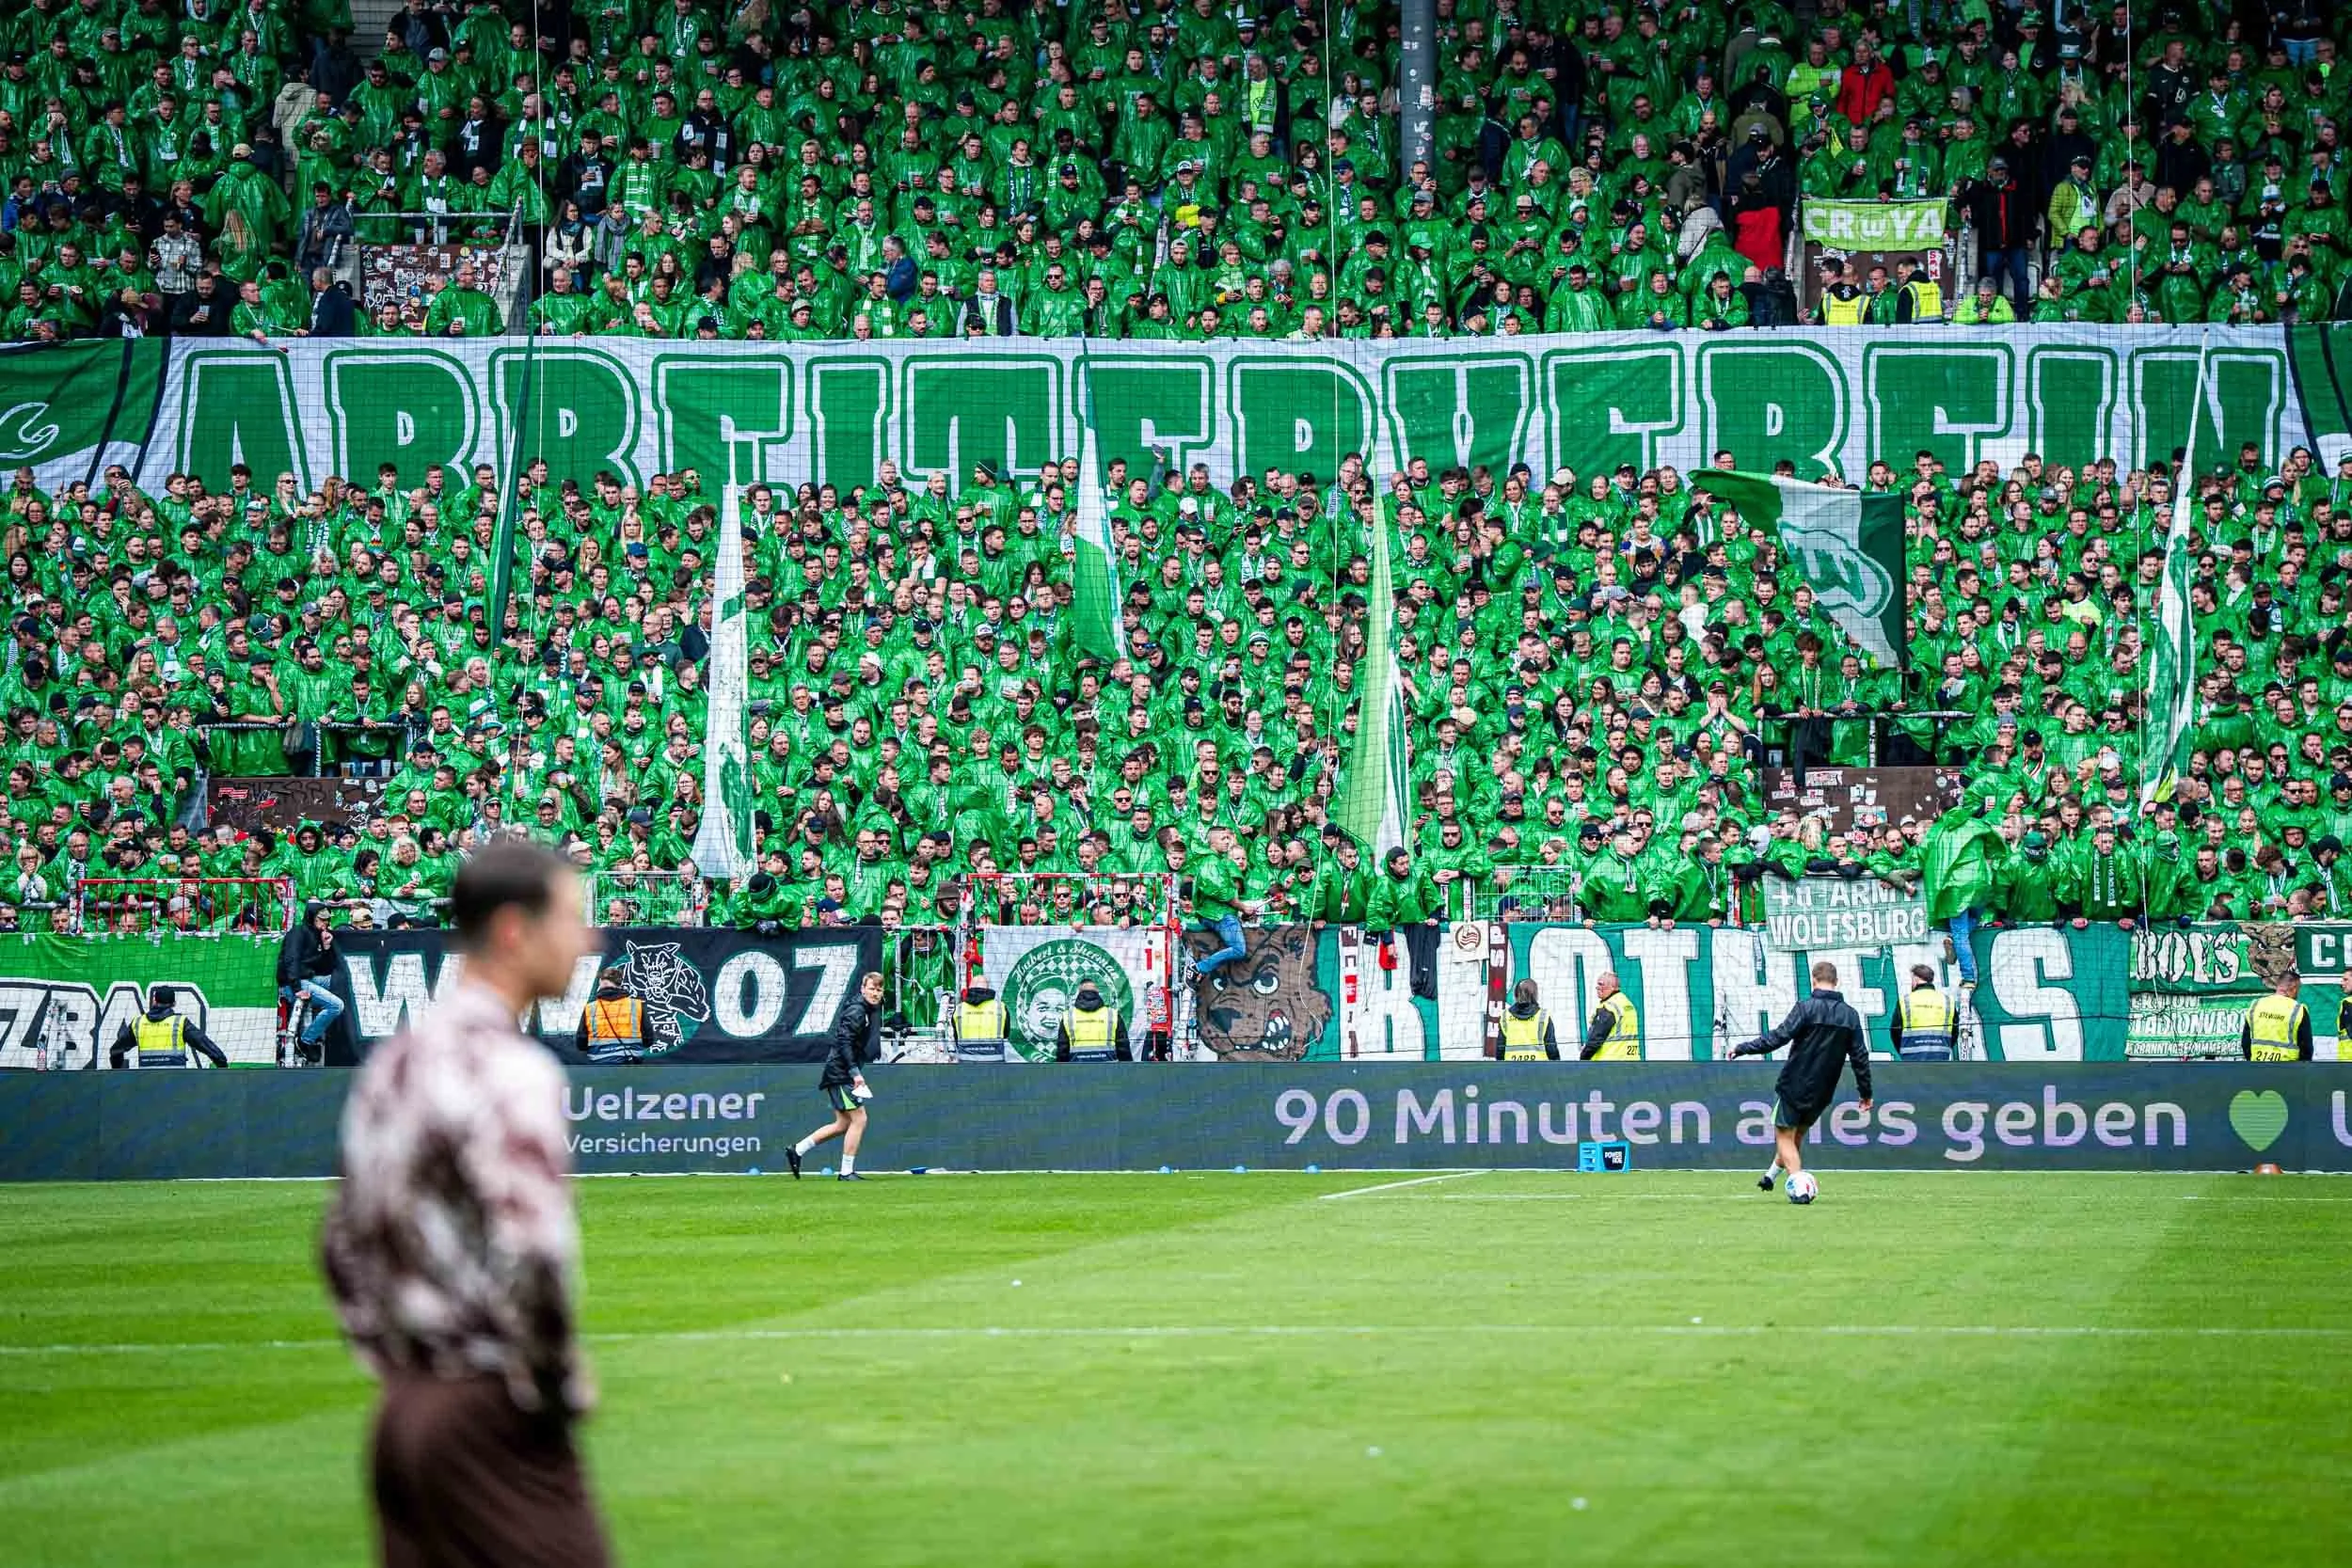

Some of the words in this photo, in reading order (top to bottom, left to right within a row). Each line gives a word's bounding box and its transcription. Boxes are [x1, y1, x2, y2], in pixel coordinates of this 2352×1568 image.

[1769, 909, 1927, 946] WOLFSBURG
[2134, 928, 2240, 984] BOYS
[714, 943, 859, 1038] 07
[2129, 1011, 2246, 1035] TADIONVER
[2258, 1011, 2286, 1022] STEWARD
[2255, 1051, 2281, 1061] 2140
[562, 1086, 766, 1120] Uelzener
[1274, 1088, 1371, 1145] 90
[1394, 1084, 1711, 1146] Minuten
[1736, 1101, 1918, 1146] aes
[1941, 1085, 2187, 1163] geben
[563, 1132, 761, 1158] Versicherungen
